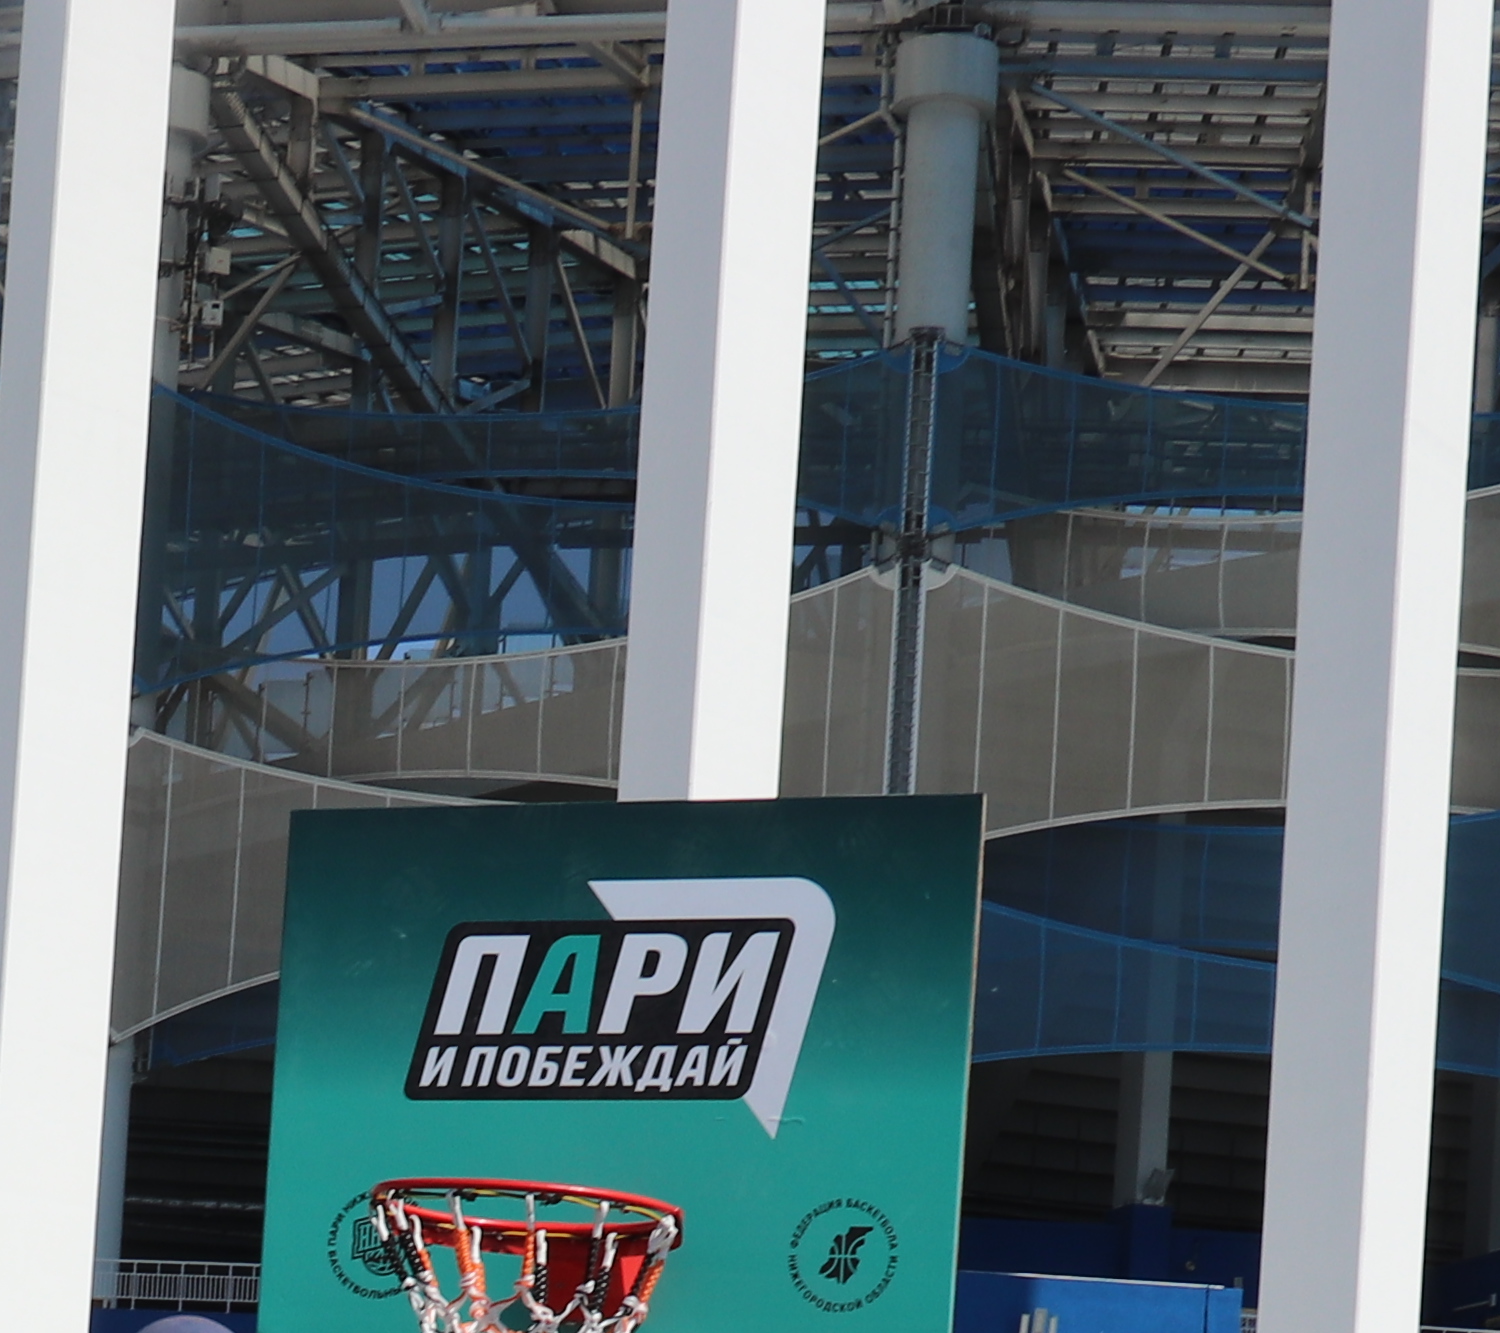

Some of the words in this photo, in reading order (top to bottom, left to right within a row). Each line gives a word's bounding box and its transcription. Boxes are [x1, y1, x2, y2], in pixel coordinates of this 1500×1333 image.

[433, 931, 781, 1035] ПАРИ
[418, 1045, 459, 1088] И
[460, 1037, 750, 1093] ПОБЕЖДАЙ
[789, 1198, 843, 1250] ФЕДЕРАЦИЯ
[846, 1198, 899, 1251] БАСКЕТБОЛА
[788, 1253, 864, 1313] НИЖЕГОРОДСКОЙ
[864, 1254, 899, 1304] ОБЛАСТИ
